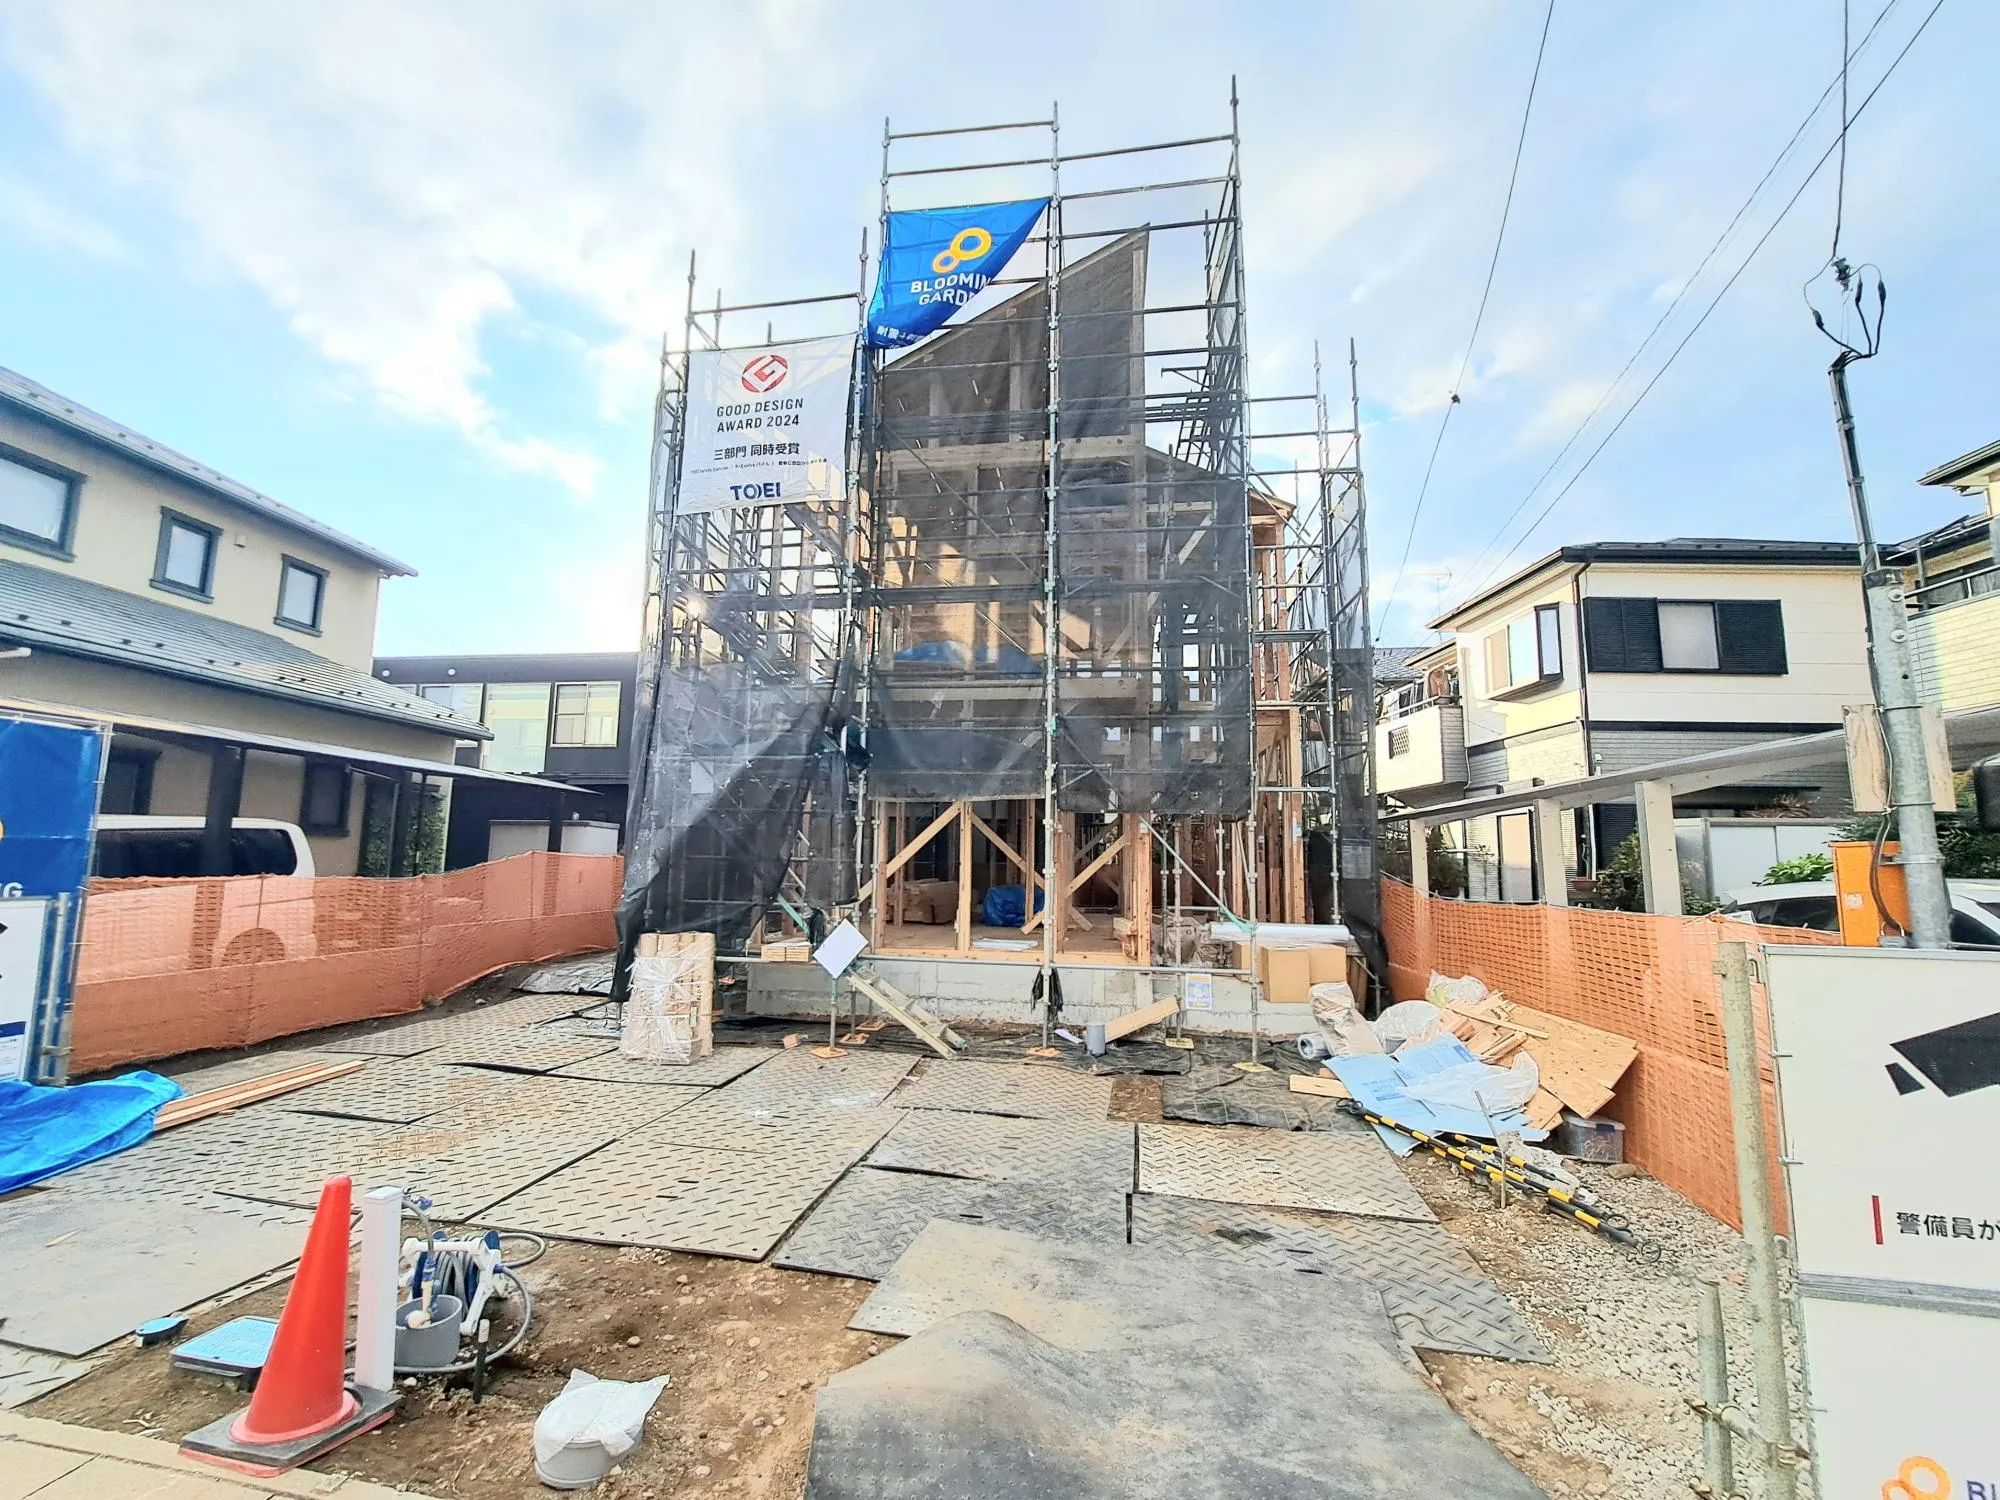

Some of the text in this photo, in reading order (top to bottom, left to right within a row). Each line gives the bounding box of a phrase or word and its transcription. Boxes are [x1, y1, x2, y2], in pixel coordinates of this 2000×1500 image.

[717, 398, 804, 417] GOOD DESIGN
[717, 414, 800, 433] AWARD 2024
[714, 442, 800, 461] 三部門 同時受賞
[0, 881, 24, 898] G
